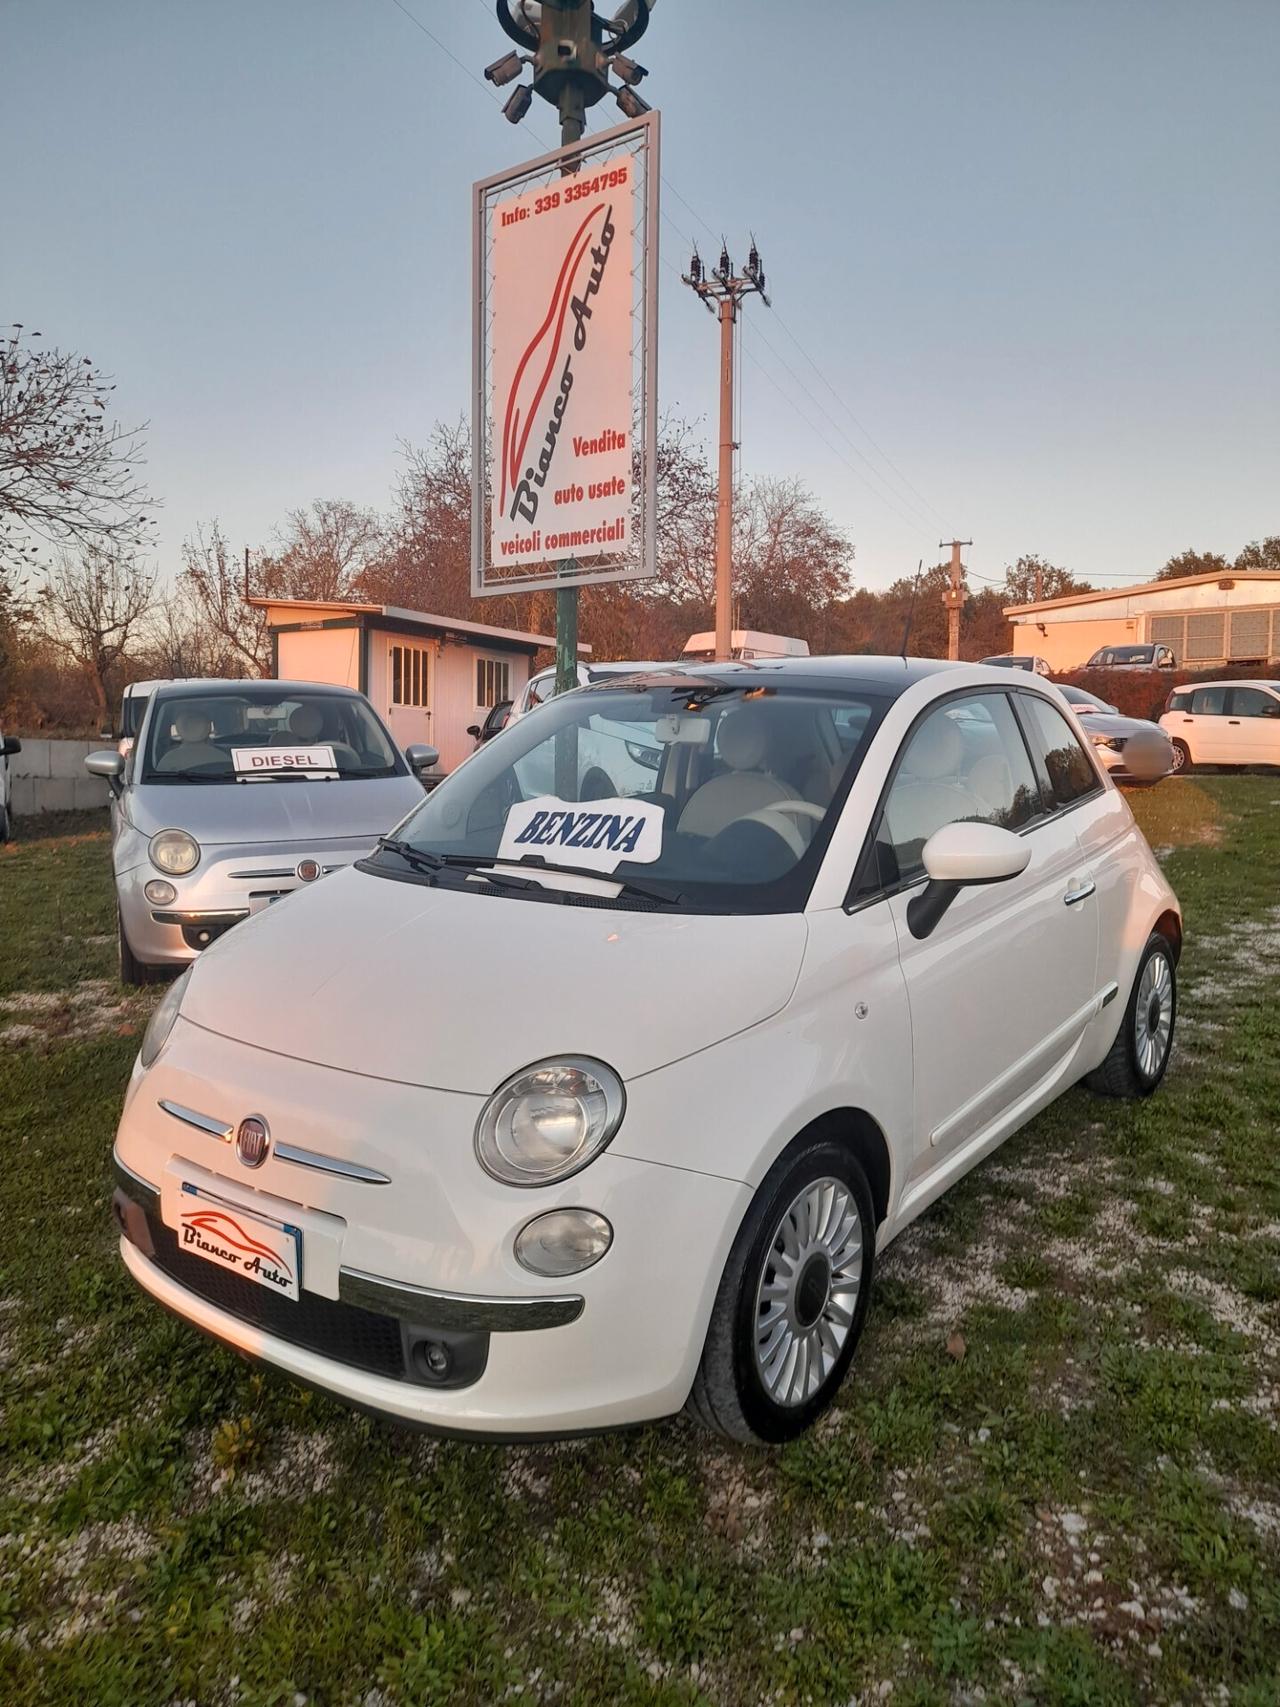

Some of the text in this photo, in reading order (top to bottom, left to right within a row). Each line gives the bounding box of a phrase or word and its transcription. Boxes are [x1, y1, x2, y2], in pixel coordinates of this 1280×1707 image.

[501, 167, 628, 227] Info: 339 3354795
[509, 204, 615, 525] Bianco Auto
[572, 429, 626, 457] Vendita
[554, 476, 625, 505] auto usate
[501, 517, 625, 555] veicoli commerciali
[251, 755, 319, 767] DIESEL
[514, 811, 647, 853] BENZINA
[181, 1222, 293, 1288] Bianco Auto
